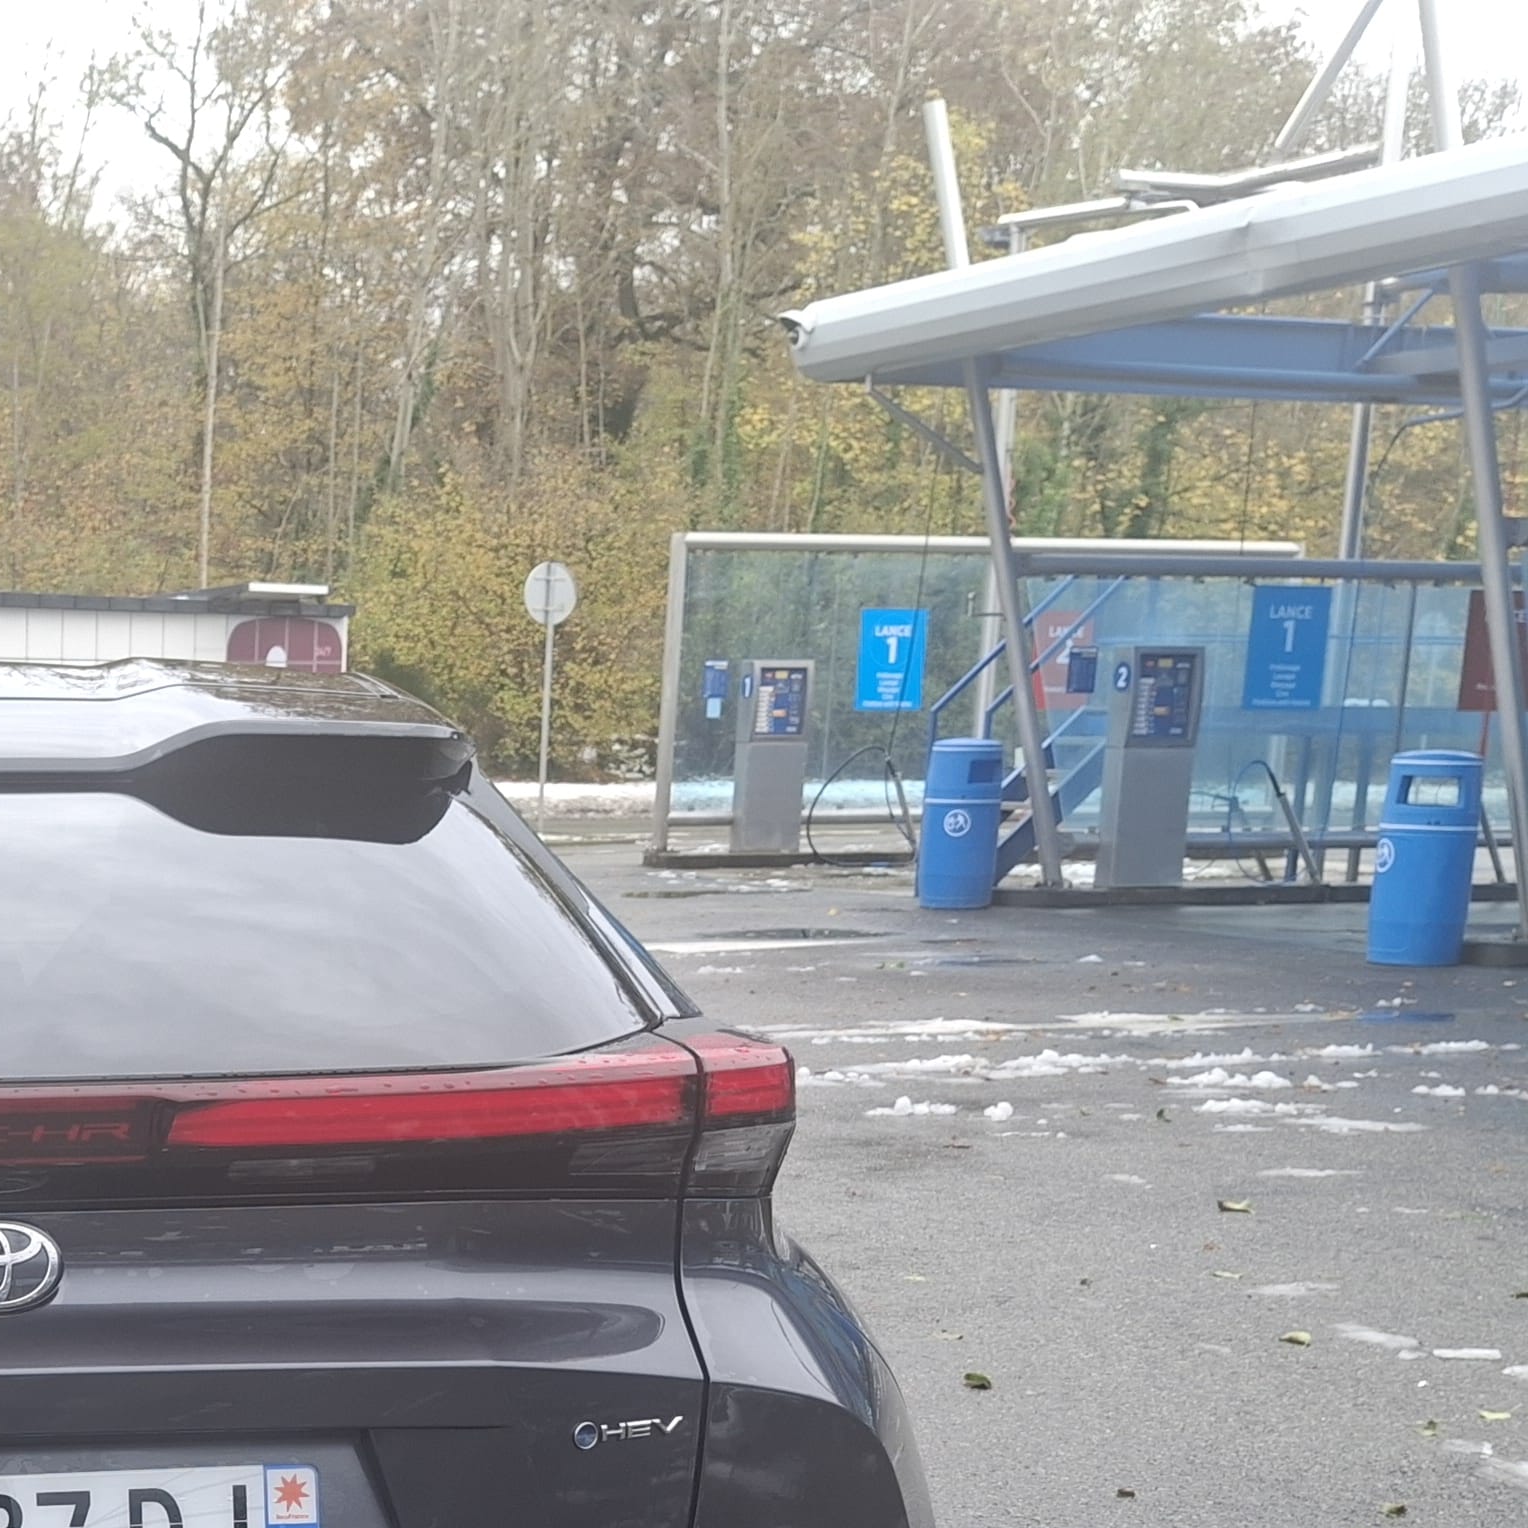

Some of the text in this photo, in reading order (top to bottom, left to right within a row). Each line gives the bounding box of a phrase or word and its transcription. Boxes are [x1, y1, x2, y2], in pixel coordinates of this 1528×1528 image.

[1269, 605, 1313, 620] LANCE
[875, 625, 913, 638] LANCE
[1283, 620, 1296, 653] 1
[886, 637, 899, 664] 1
[743, 676, 752, 698] 1
[1117, 666, 1129, 688] 2
[600, 1416, 684, 1441] HEV
